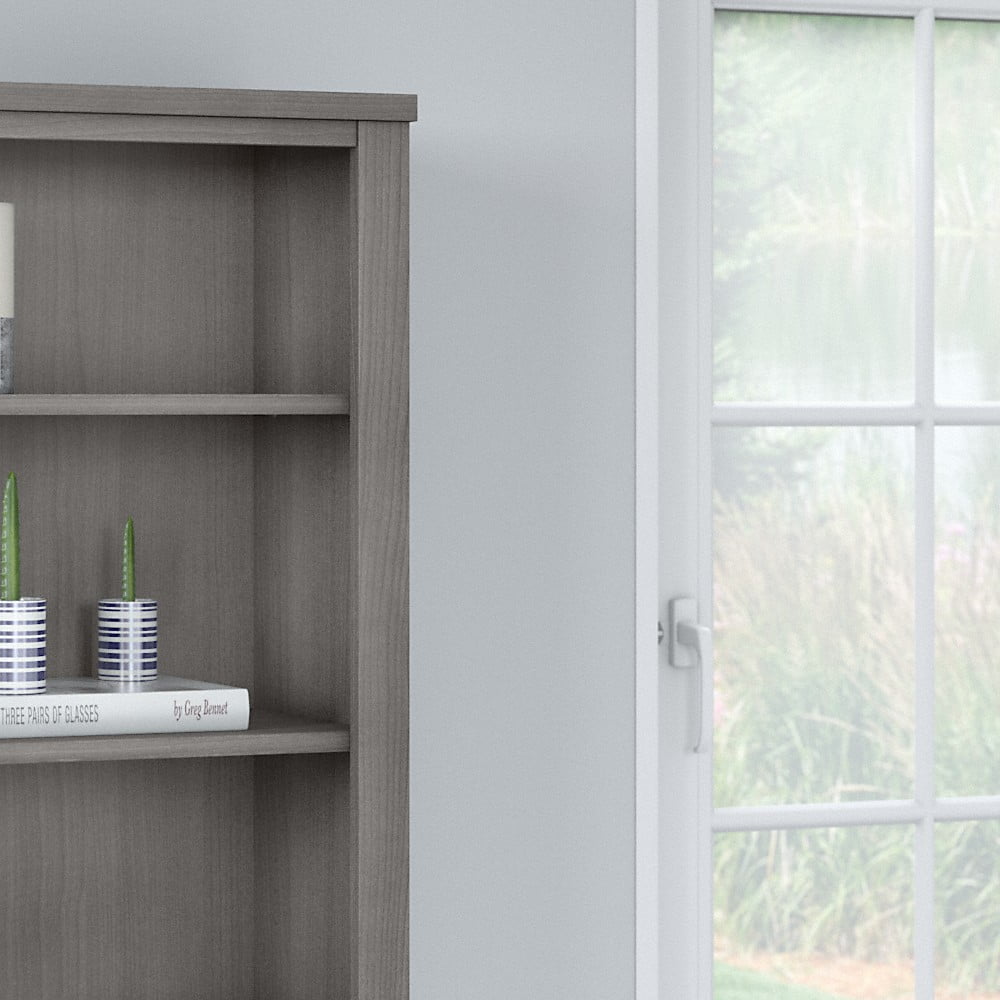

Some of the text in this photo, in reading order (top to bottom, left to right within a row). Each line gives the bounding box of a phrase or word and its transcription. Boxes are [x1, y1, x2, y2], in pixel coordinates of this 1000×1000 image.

[0, 704, 100, 725] THREE PAIRS OF GLASSES
[173, 699, 228, 721] by Greg Bennet
